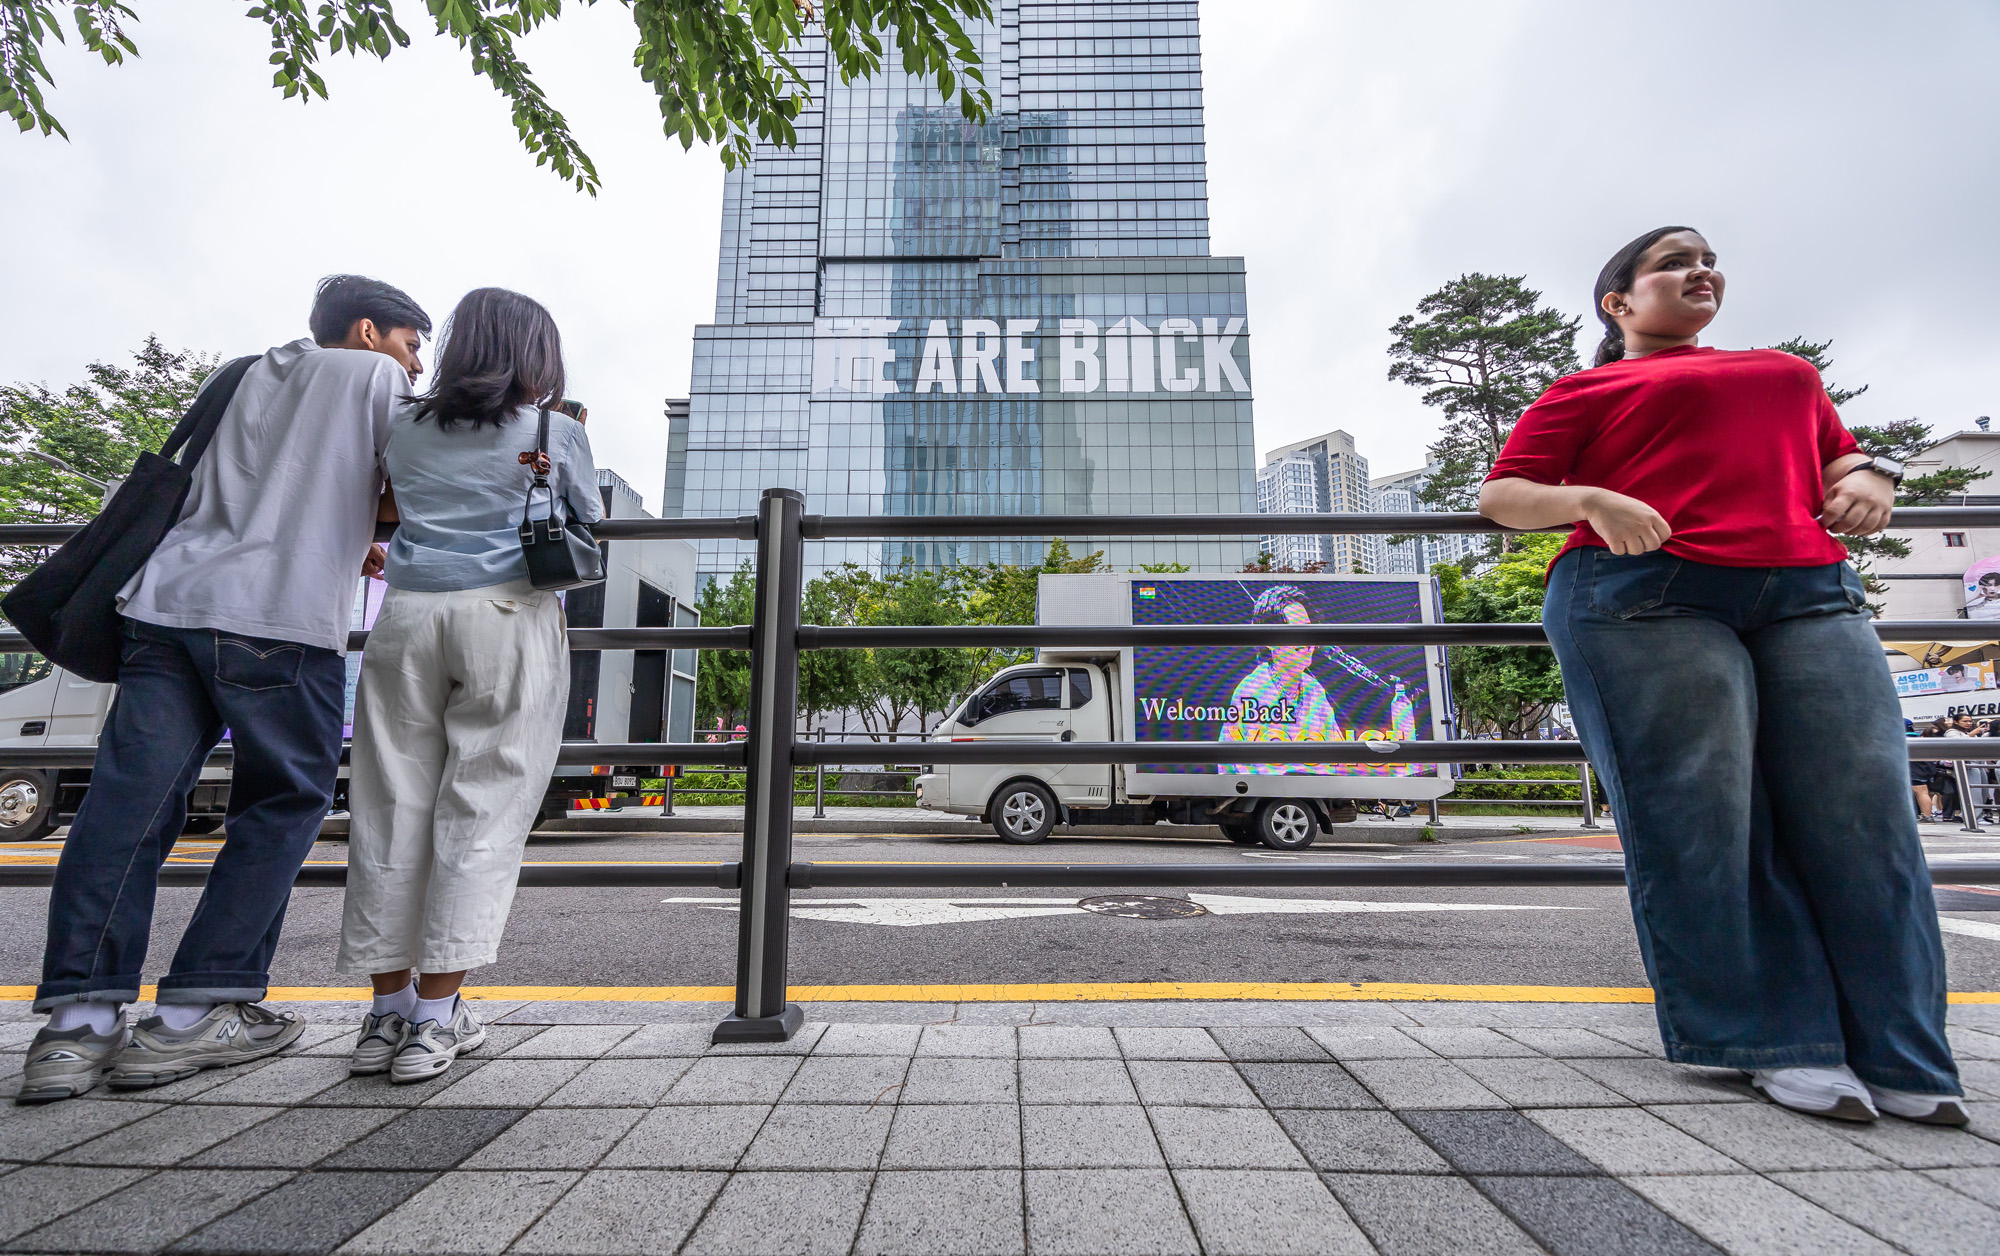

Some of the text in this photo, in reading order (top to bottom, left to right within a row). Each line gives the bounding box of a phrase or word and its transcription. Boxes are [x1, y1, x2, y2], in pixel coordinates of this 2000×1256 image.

[914, 319, 1041, 394] ARE
[1139, 697, 1296, 723] Welcome Back
[1948, 703, 2000, 717] REVER
